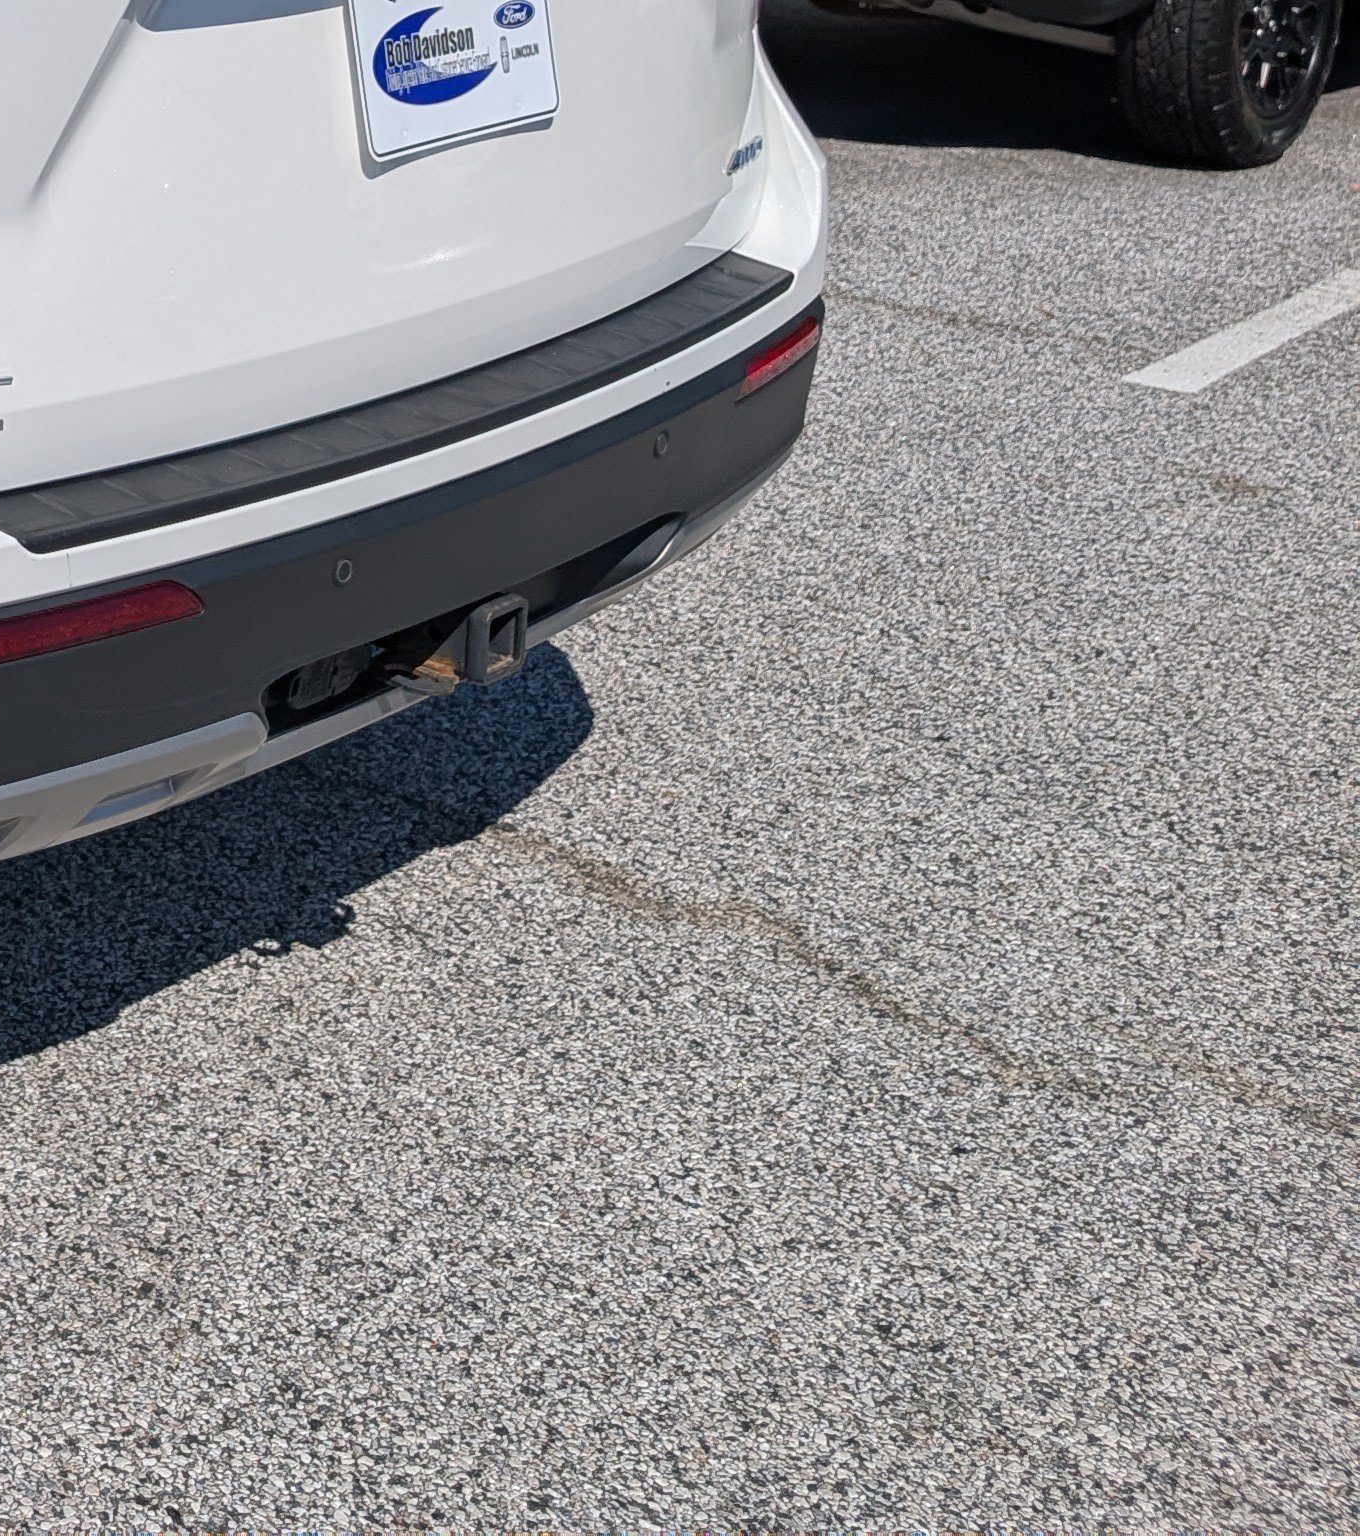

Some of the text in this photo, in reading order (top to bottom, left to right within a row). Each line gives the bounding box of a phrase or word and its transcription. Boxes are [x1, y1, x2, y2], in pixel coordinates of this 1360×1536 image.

[500, 3, 528, 25] Ford
[385, 27, 476, 68] Bob Davidson
[511, 43, 540, 61] LINCOLN
